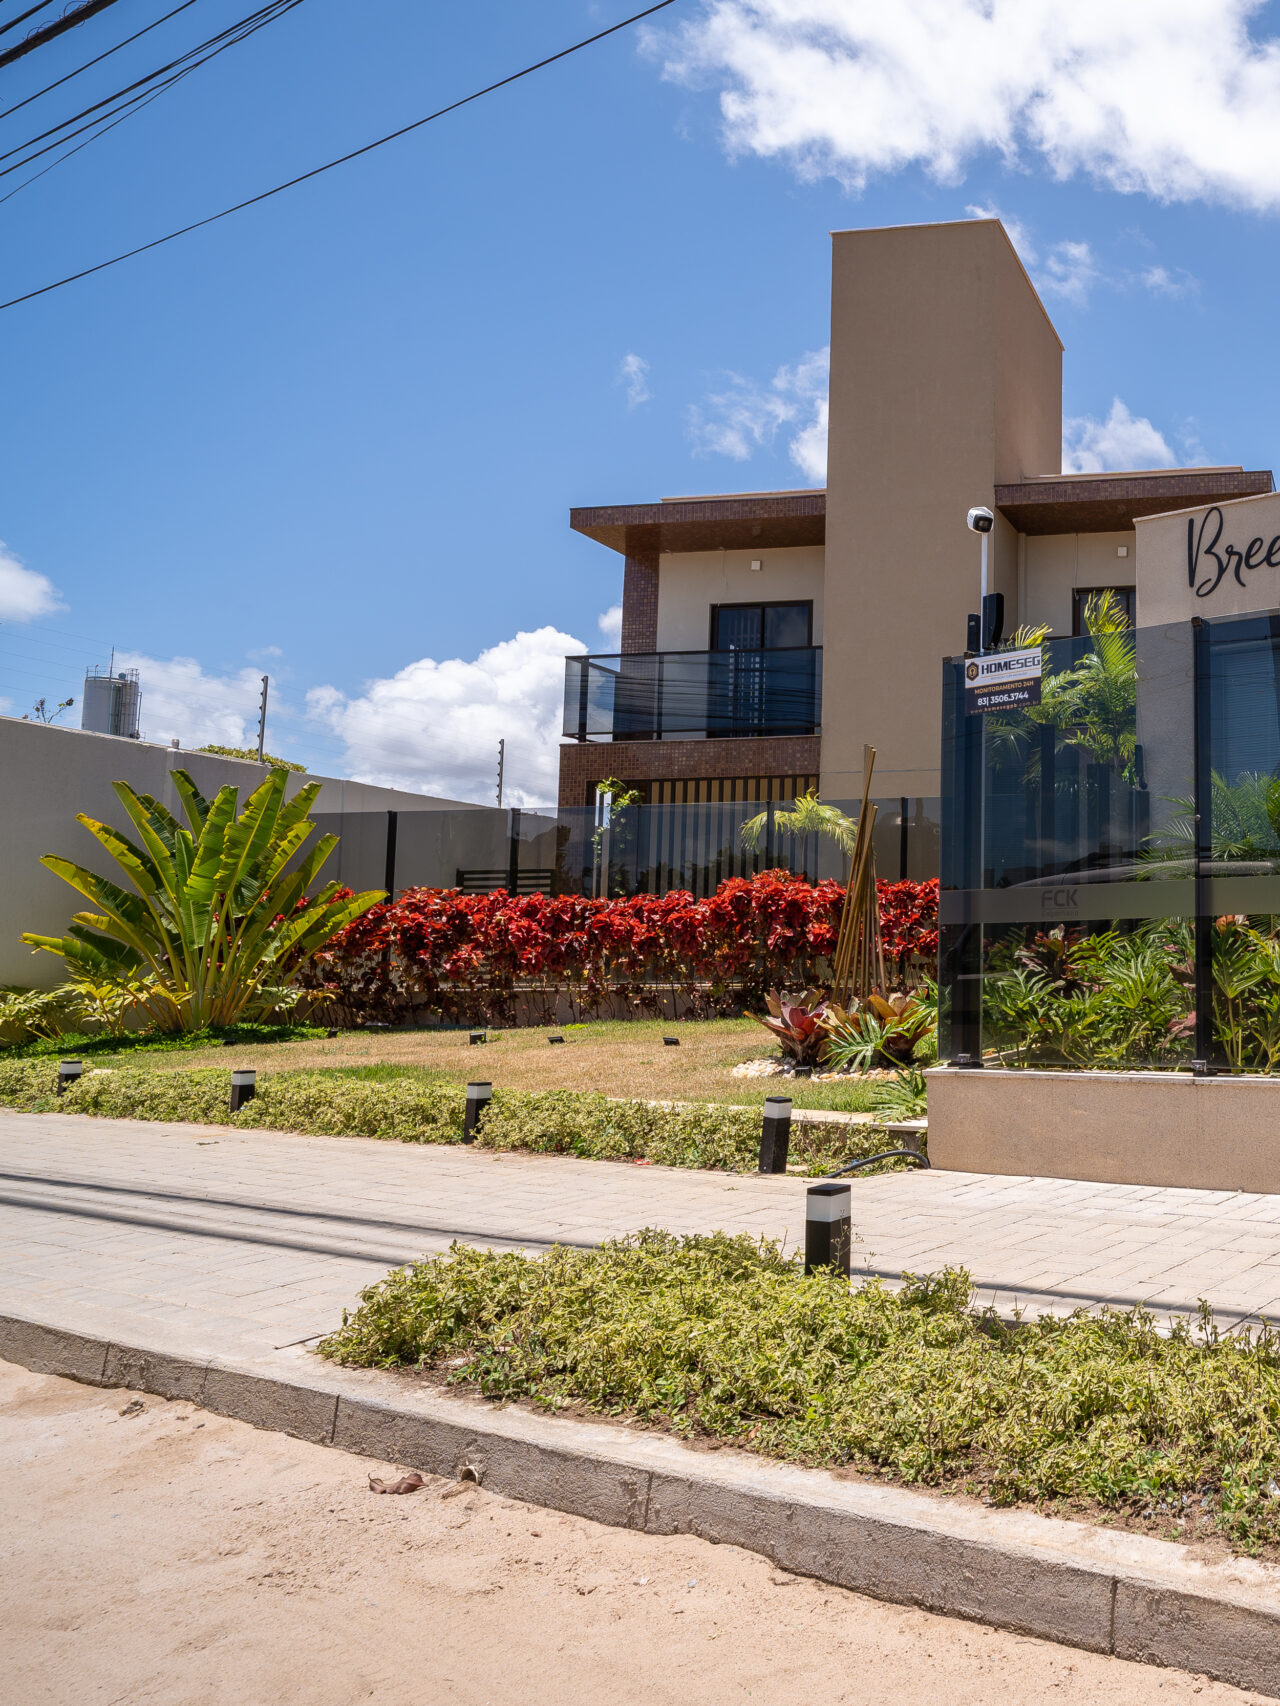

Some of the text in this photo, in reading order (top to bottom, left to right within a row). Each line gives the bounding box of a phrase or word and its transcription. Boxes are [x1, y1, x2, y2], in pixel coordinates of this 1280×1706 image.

[982, 656, 1040, 674] HOMESEG
[975, 683, 1022, 694] MONITORAMENTO
[990, 691, 1028, 703] 3506.3744
[1042, 888, 1079, 908] FCK
